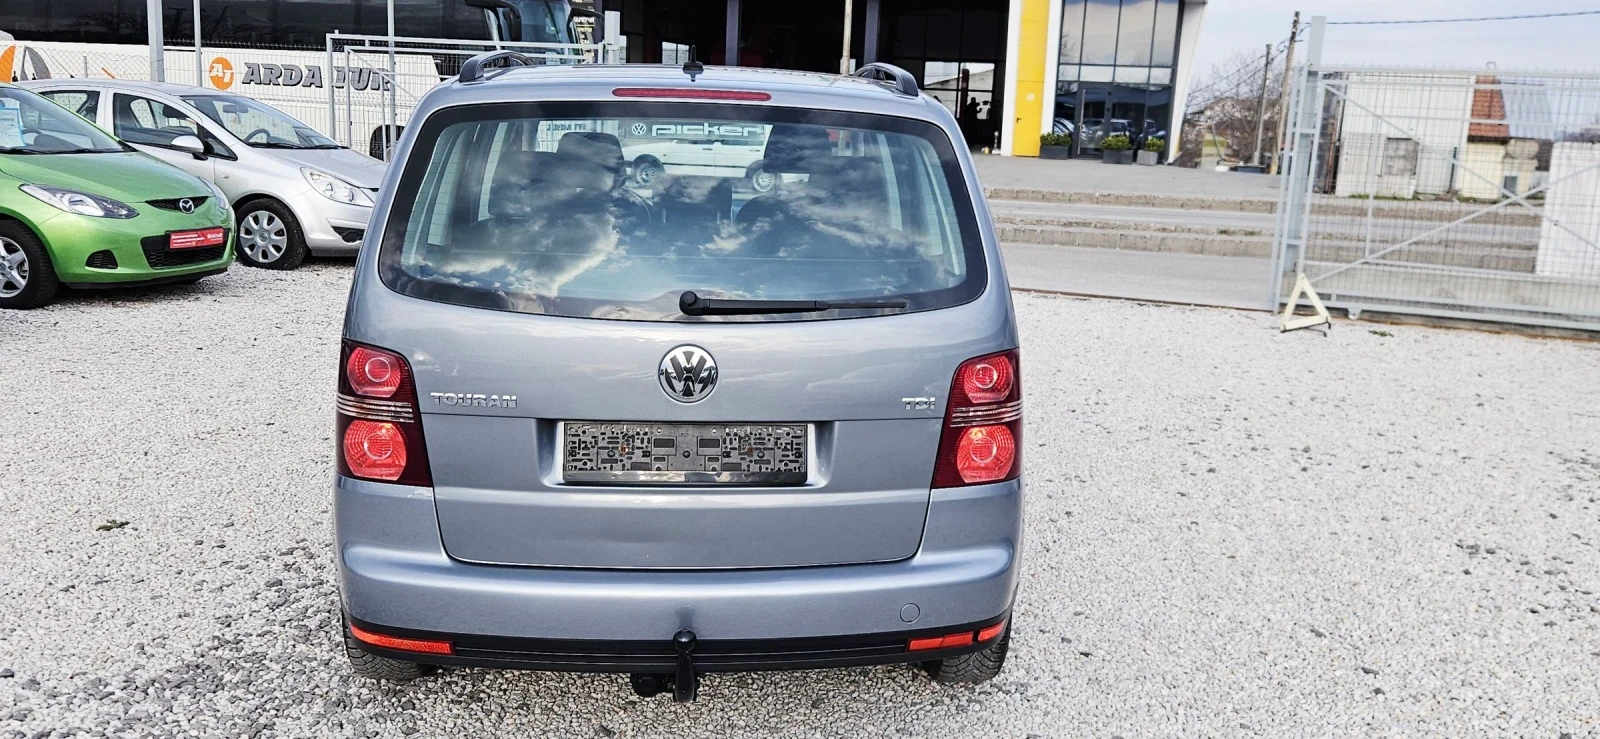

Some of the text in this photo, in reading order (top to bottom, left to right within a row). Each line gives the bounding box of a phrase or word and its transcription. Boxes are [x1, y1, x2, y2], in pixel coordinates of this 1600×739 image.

[241, 62, 391, 91] ARDA TUR
[651, 122, 765, 137] picker
[430, 392, 518, 409] TOURAN
[901, 396, 936, 410] TDI
